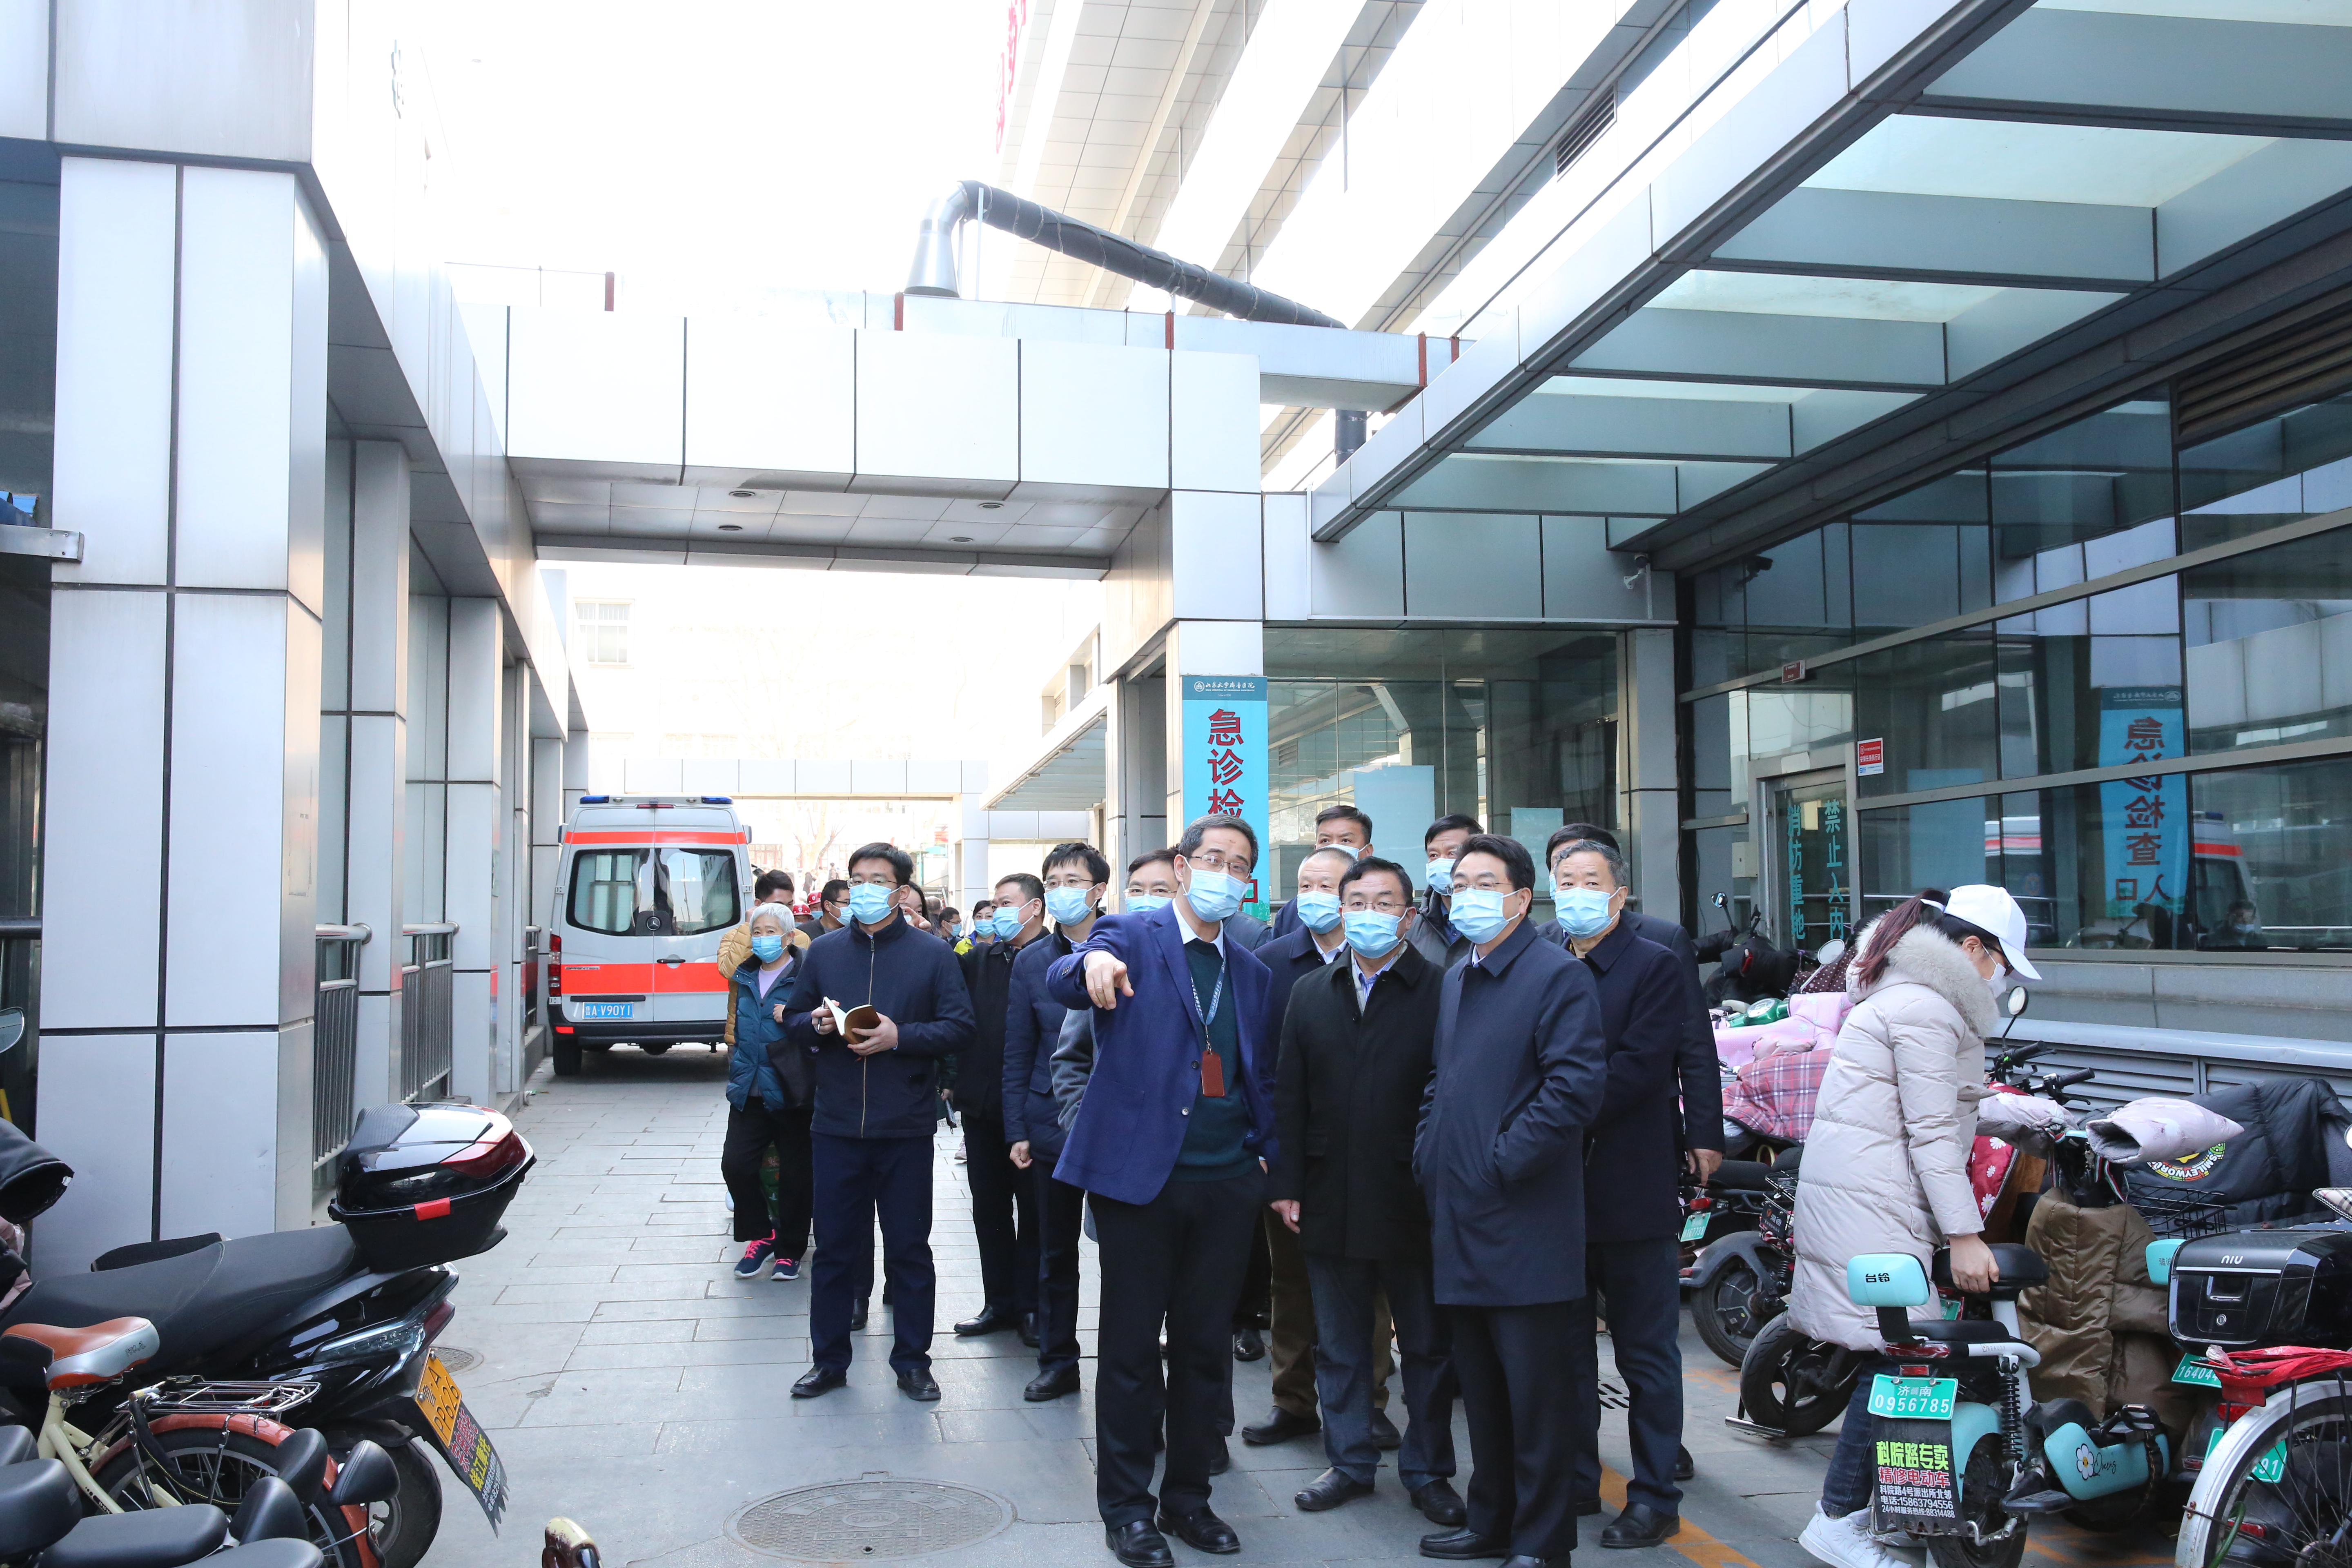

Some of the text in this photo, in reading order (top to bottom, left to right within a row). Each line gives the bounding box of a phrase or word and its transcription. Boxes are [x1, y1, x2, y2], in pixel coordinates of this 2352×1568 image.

[1787, 804, 1806, 940] 消防重地
[1824, 799, 1844, 939] 禁止入内
[1865, 1273, 1890, 1283] 台铃
[433, 1375, 459, 1441] PP626
[1875, 1394, 1950, 1413] 0956785
[1875, 1441, 1949, 1470] 科院路专卖
[1878, 1466, 1951, 1488] 精修电动车
[1879, 1484, 1952, 1500] 科院路4号派出所北邻
[1881, 1495, 1953, 1510] 电话:15863794556
[1882, 1504, 1955, 1518] 24小时服务热线:88314488
